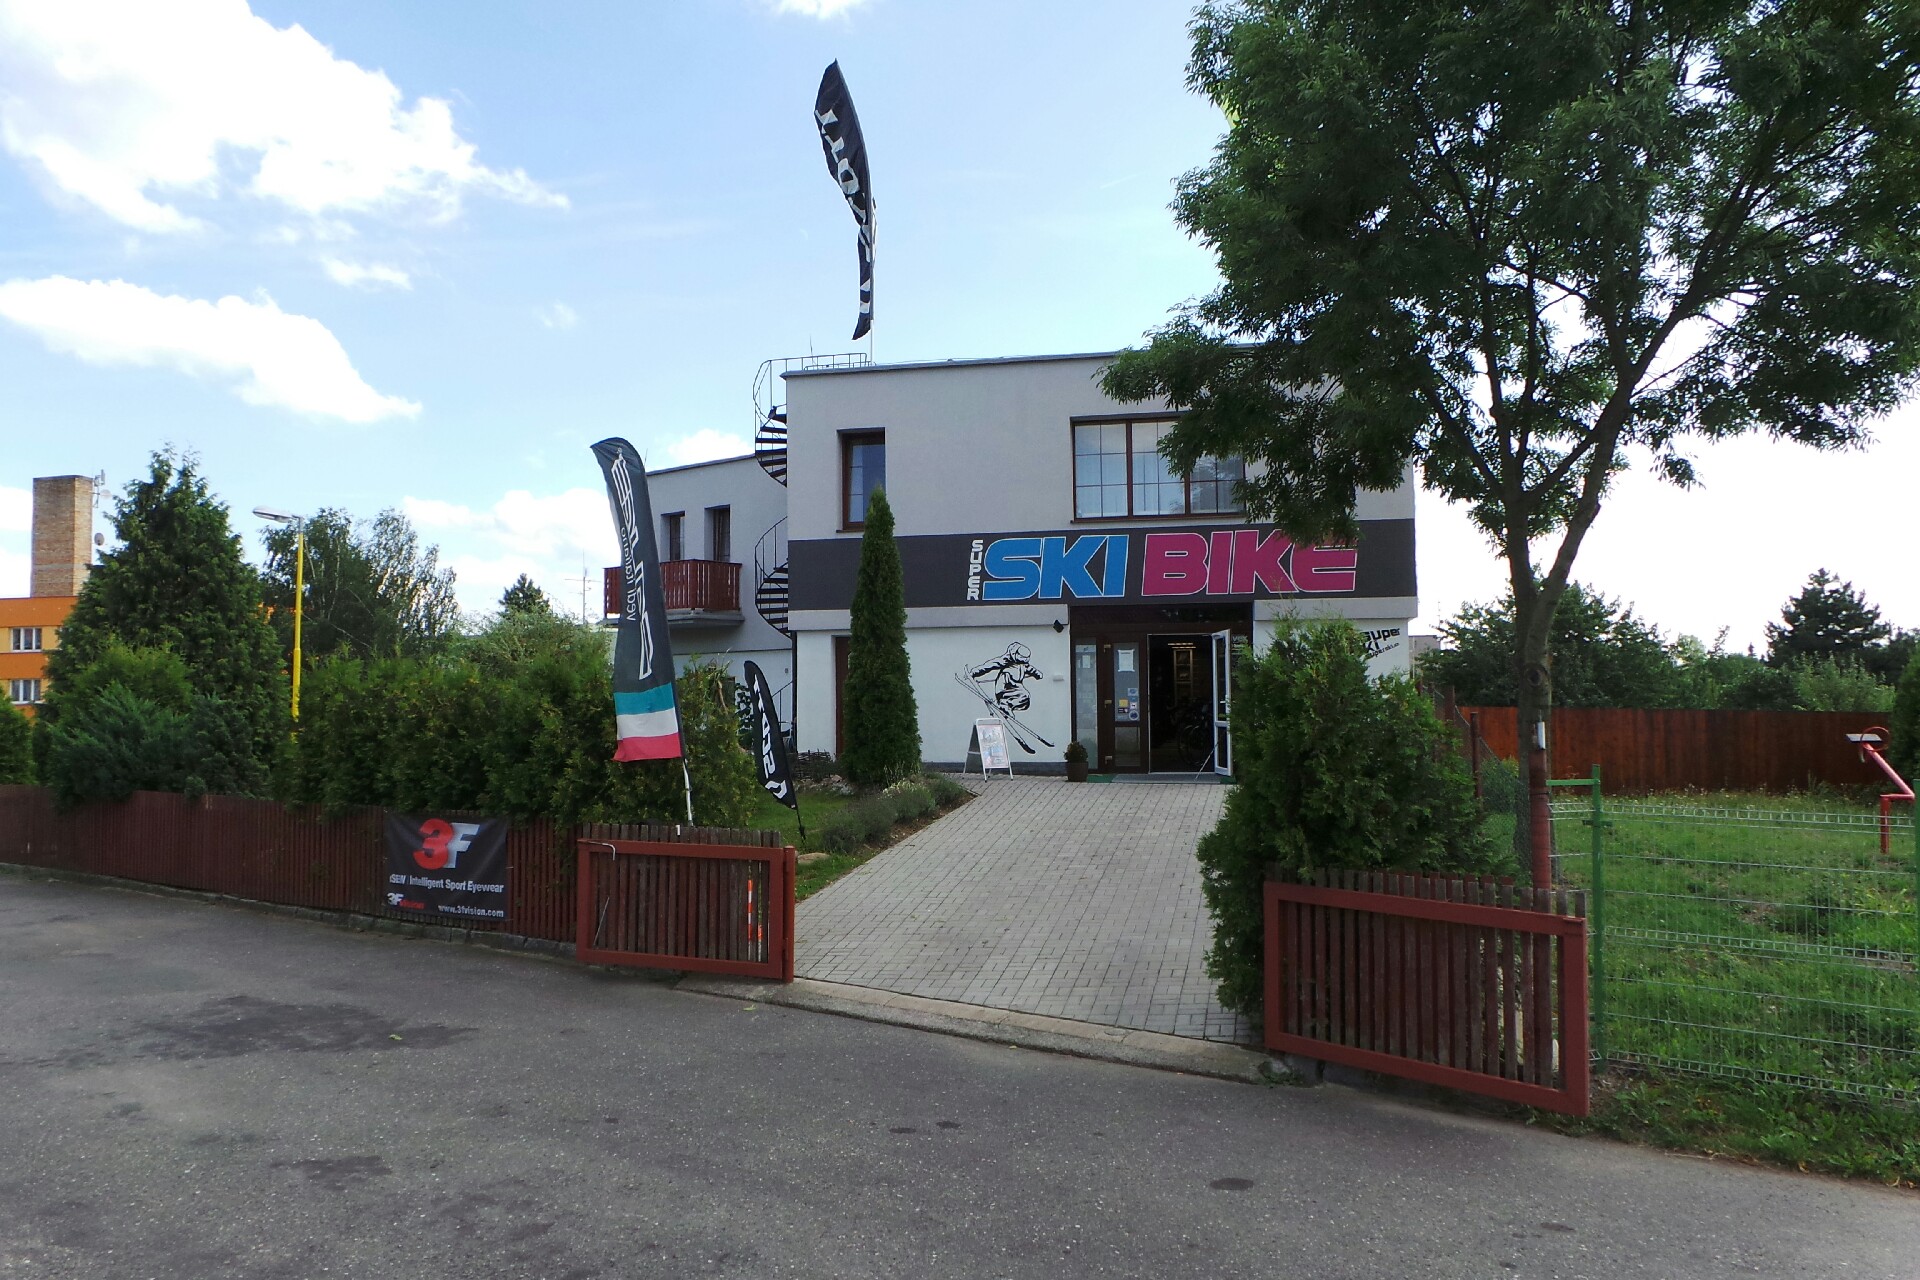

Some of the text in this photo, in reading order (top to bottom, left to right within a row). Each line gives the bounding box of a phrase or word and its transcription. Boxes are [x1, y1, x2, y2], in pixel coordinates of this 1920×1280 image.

[966, 539, 984, 601] SUPER
[982, 529, 1358, 601] SKI BIKE
[413, 819, 480, 870] 3F
[409, 875, 444, 889] Intelligent
[445, 878, 467, 892] Sport
[467, 880, 504, 894] Eyewear
[438, 904, 504, 918] www.3fvision.com
